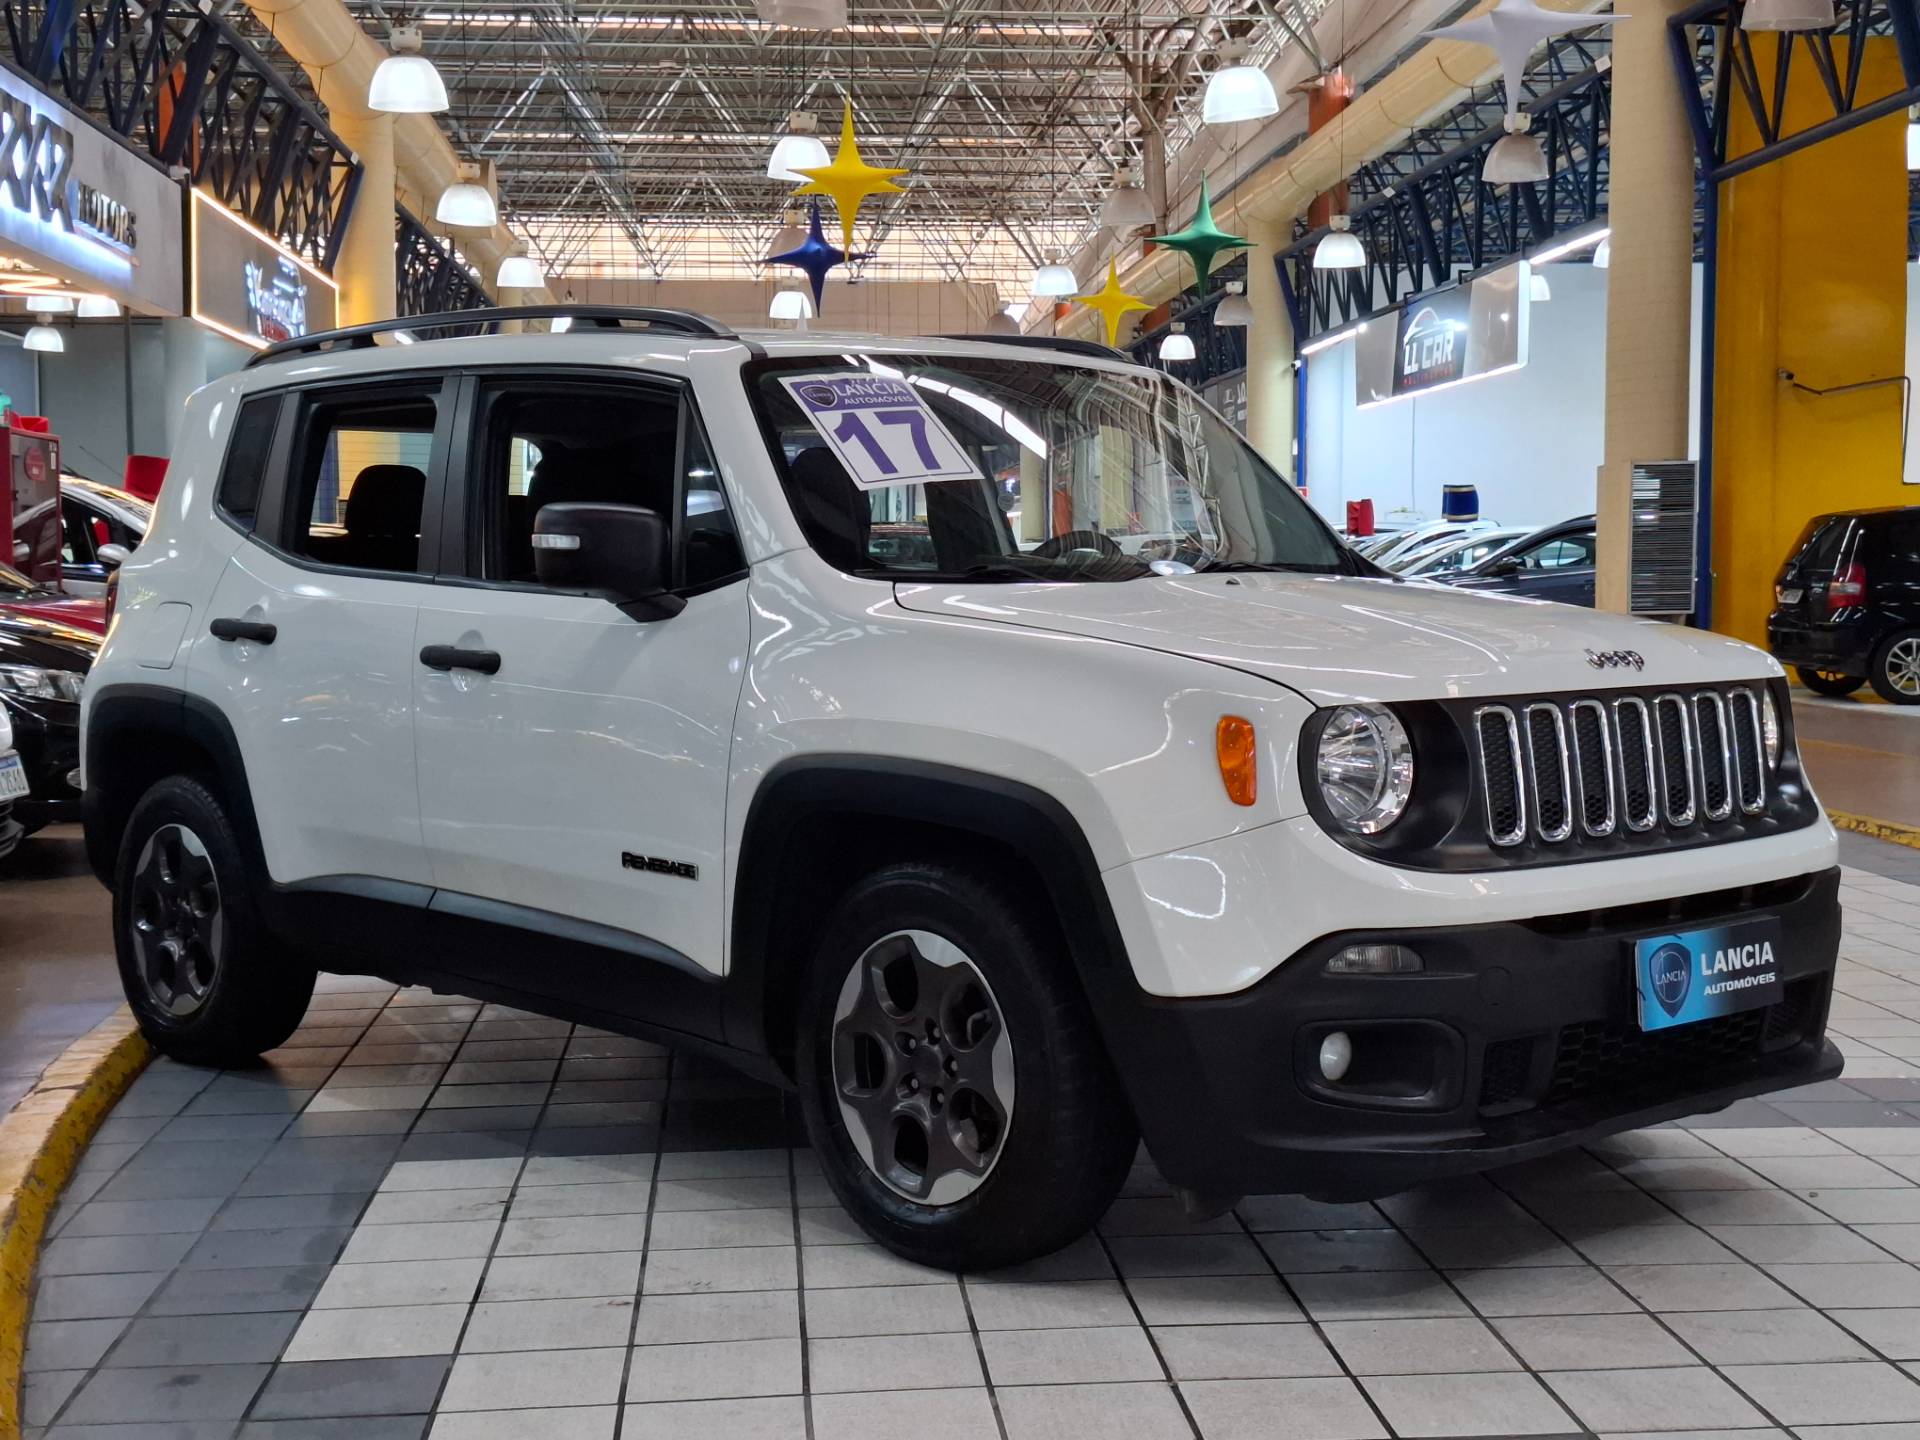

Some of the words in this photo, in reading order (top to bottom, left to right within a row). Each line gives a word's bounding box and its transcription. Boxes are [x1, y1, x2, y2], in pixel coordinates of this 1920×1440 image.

[78, 180, 137, 249] MOTORS
[1421, 330, 1454, 370] CAR
[832, 383, 908, 397] LANCIA
[833, 410, 942, 475] 17
[1583, 648, 1645, 672] Jeep
[621, 851, 699, 881] RENEGADE
[1701, 941, 1775, 976] LANCIA
[1655, 970, 1687, 985] LANCIA
[1703, 972, 1776, 996] AUTOMÓVEIS
